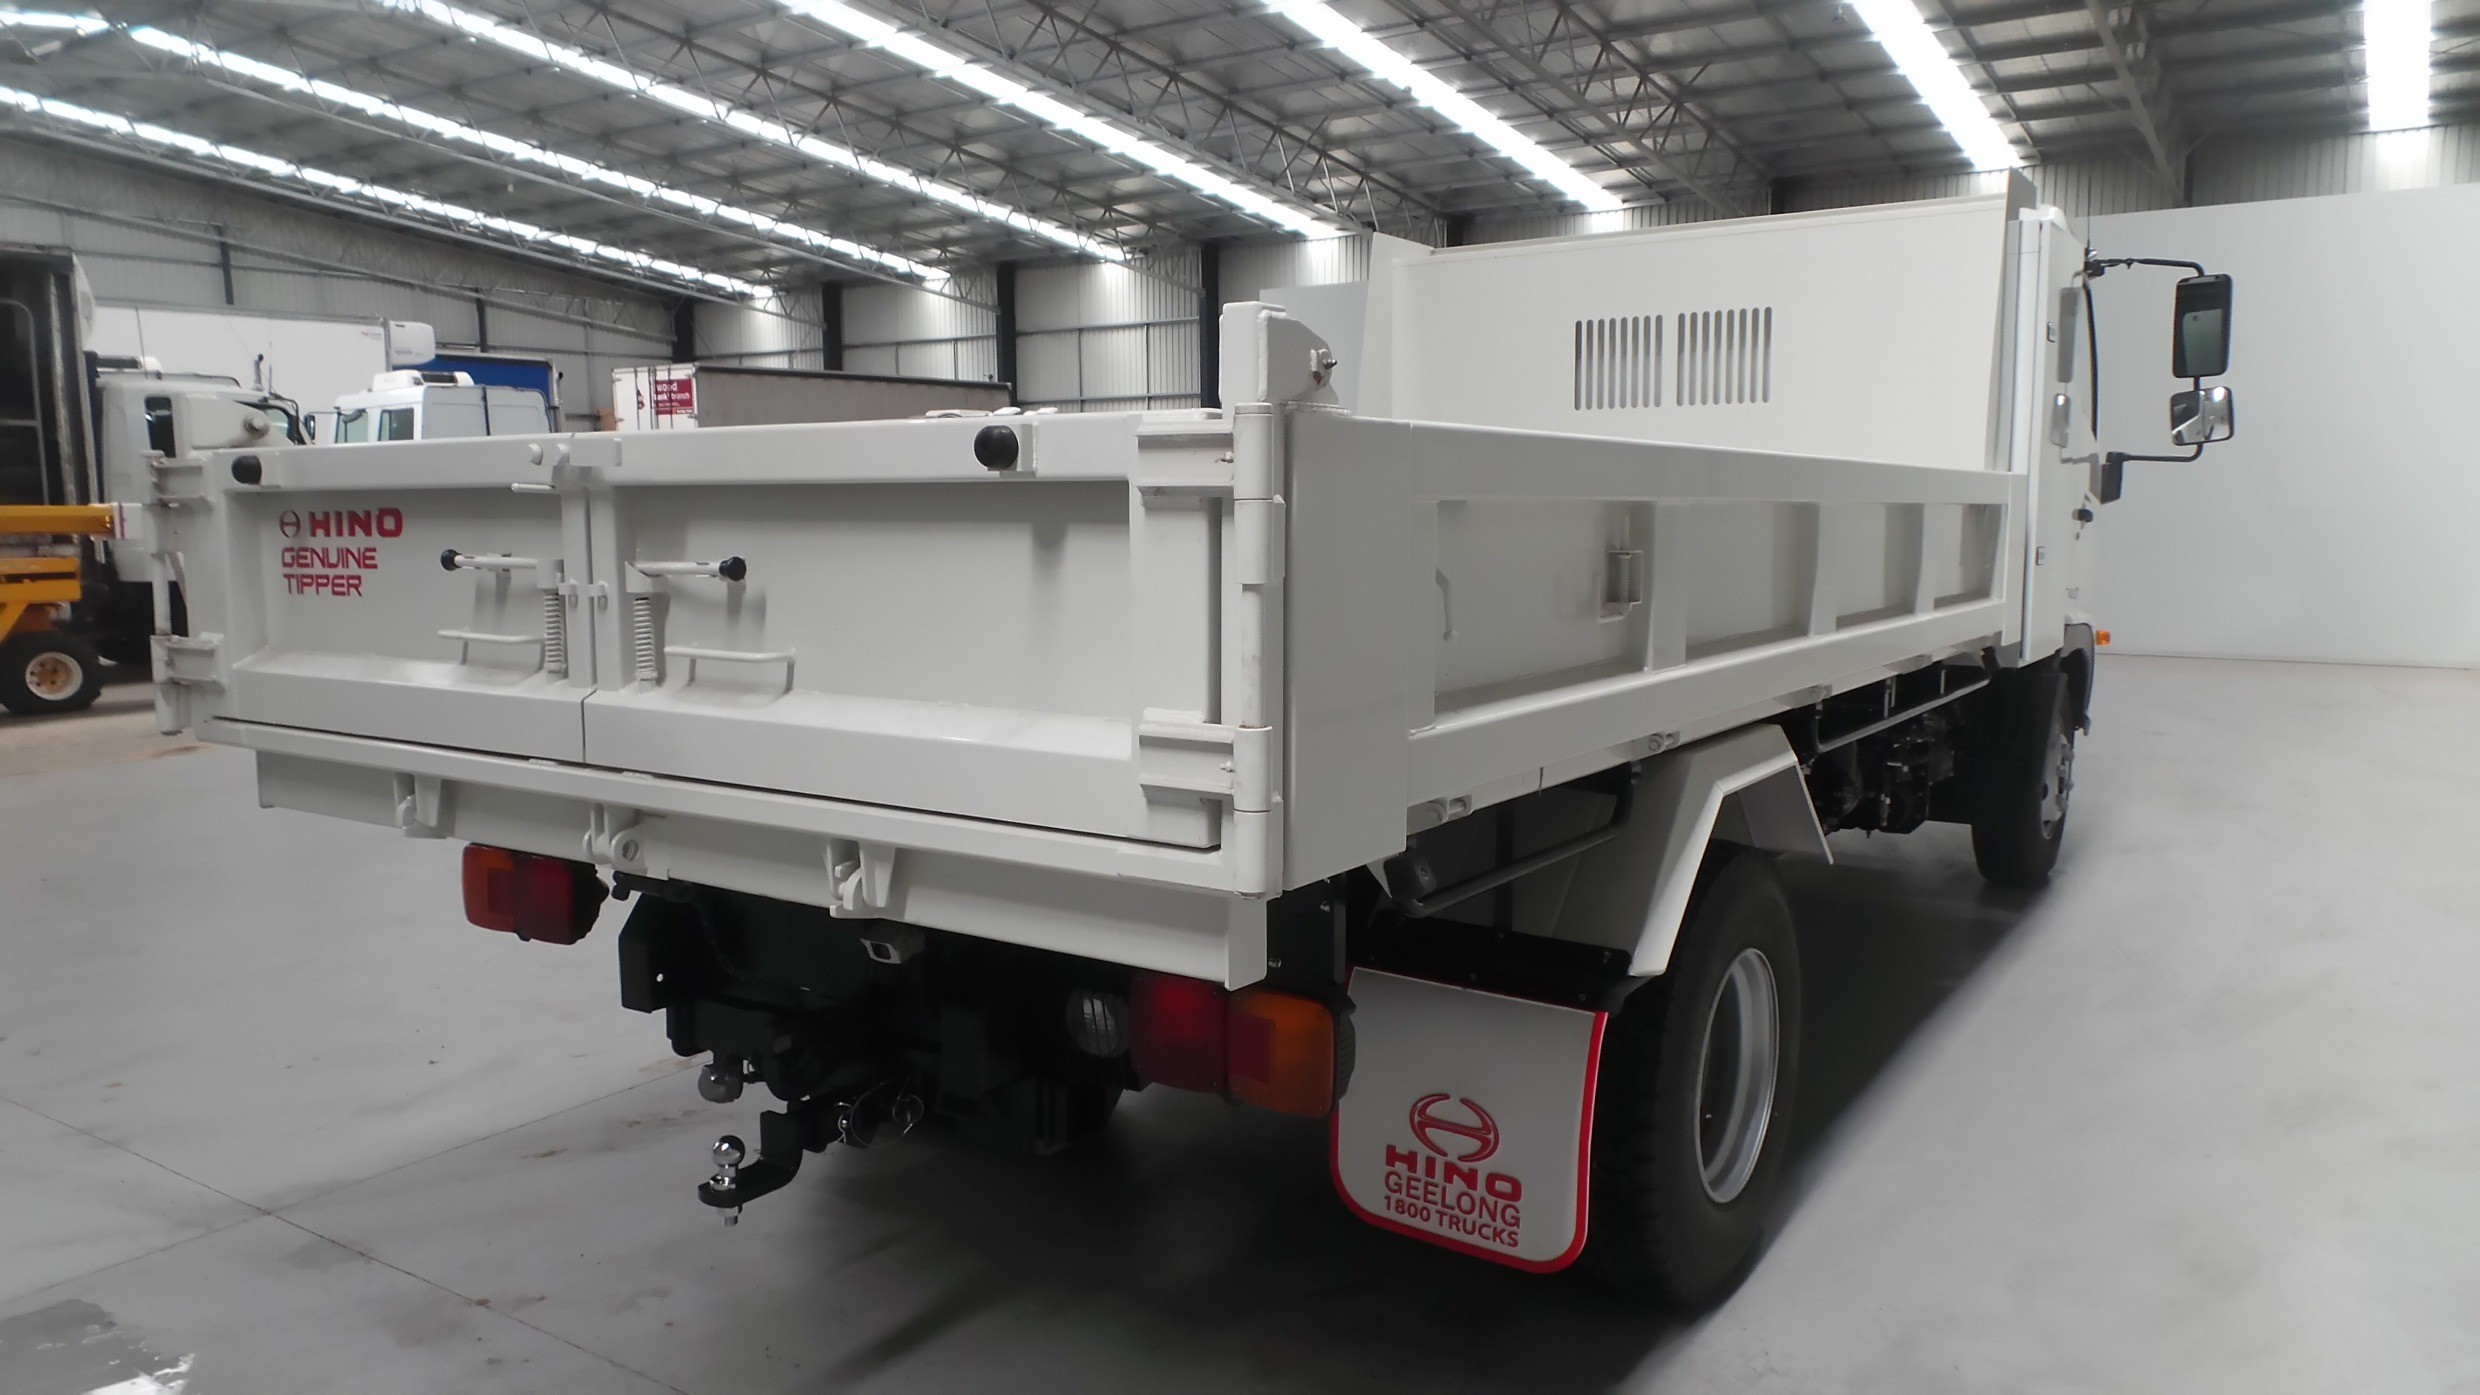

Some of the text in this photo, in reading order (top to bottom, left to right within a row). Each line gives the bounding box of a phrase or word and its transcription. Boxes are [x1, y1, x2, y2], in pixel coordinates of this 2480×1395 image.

[309, 508, 404, 538] HINO
[281, 547, 378, 570] GENUINE
[283, 573, 363, 597] TIPPER
[1385, 1144, 1522, 1203] HINO
[1384, 1171, 1521, 1229] GEELONG
[1384, 1195, 1519, 1248] 1800 TRUCKS
